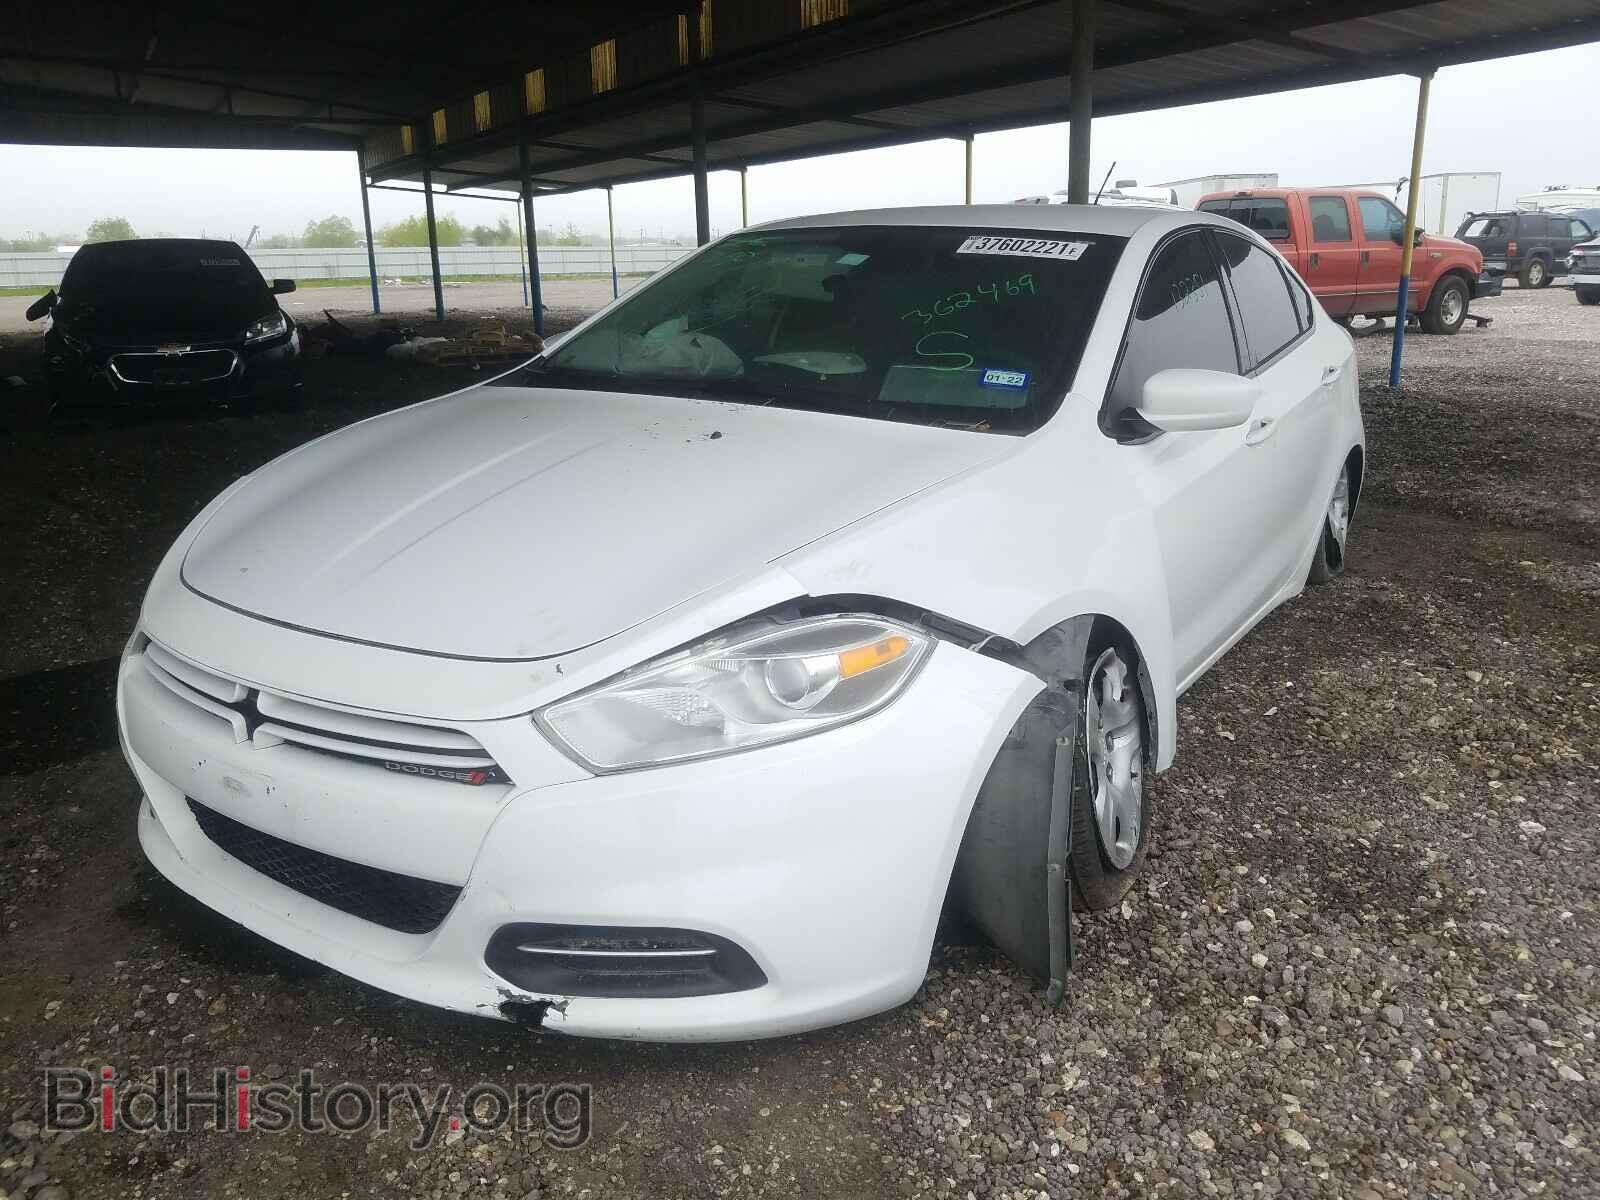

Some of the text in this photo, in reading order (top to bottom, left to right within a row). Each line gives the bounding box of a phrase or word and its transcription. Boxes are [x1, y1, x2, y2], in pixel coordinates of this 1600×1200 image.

[976, 237, 1069, 255] 37602221
[916, 330, 973, 371] S
[384, 761, 473, 781] DODGE
